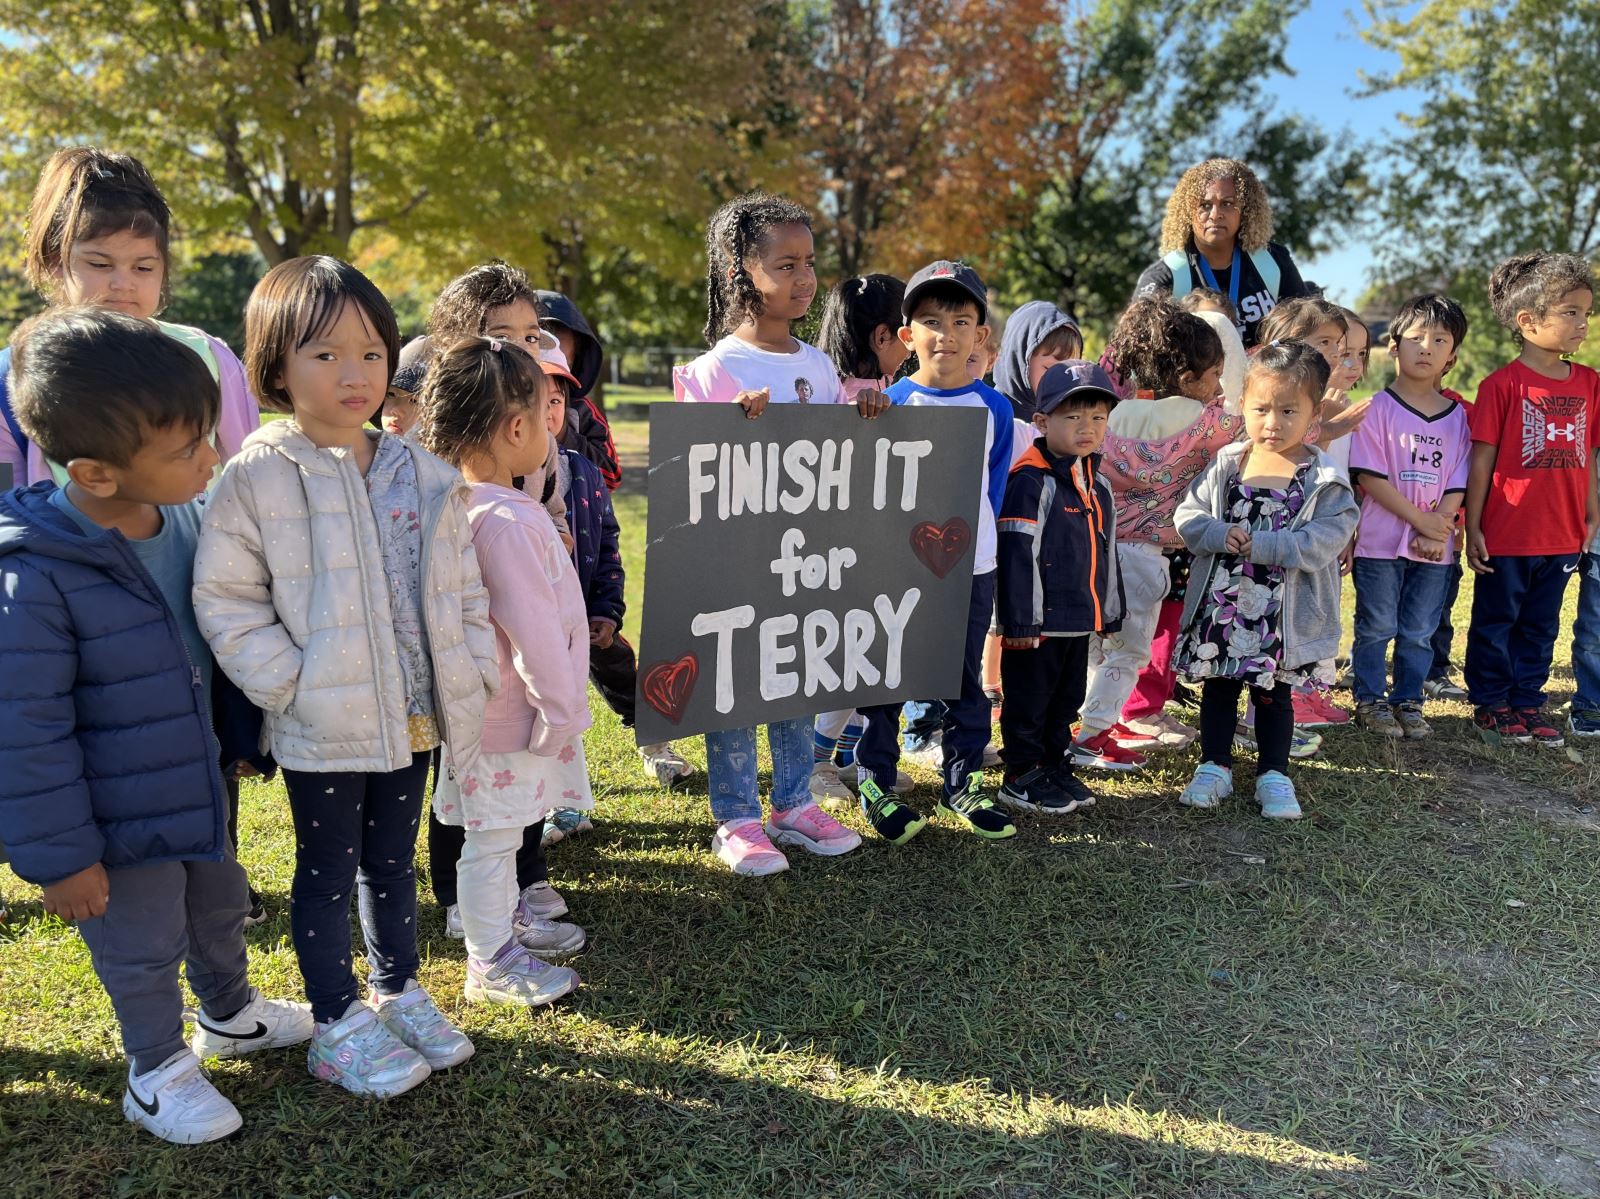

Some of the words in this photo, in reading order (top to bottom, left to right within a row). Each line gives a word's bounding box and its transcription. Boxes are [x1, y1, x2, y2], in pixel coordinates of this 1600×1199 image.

[1414, 434, 1442, 447] ENZO
[1522, 399, 1535, 467] UNDER
[1535, 409, 1546, 453] ARMOUR
[689, 438, 854, 525] FINISH
[873, 437, 933, 512] IT
[770, 527, 857, 597] for
[691, 587, 921, 714] TERRY
